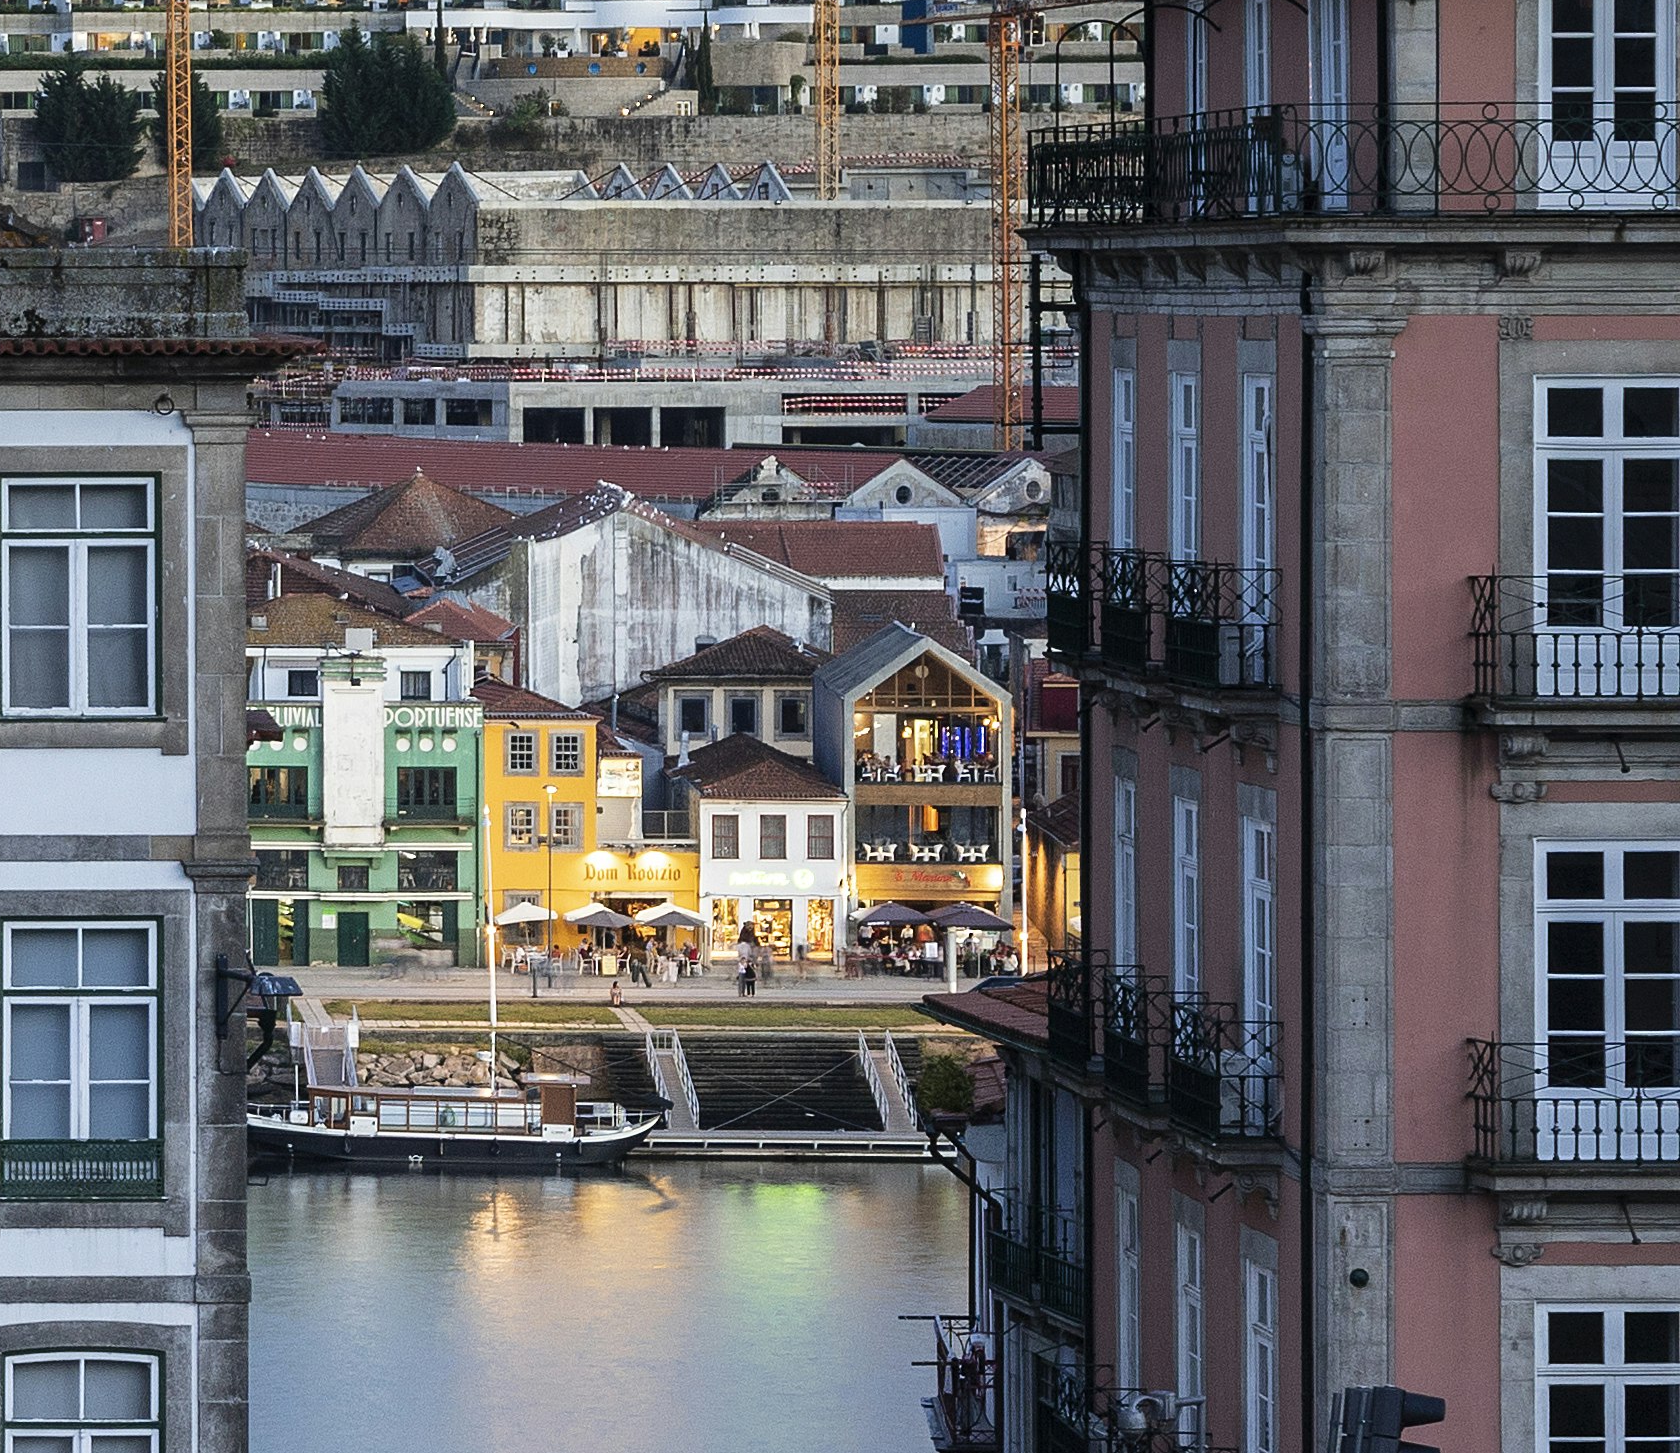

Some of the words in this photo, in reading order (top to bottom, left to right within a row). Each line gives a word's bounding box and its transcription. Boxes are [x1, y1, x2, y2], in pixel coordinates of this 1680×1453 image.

[384, 707, 482, 728] PORTUENSE
[583, 862, 618, 881] Dom
[625, 862, 681, 881] Rodizio
